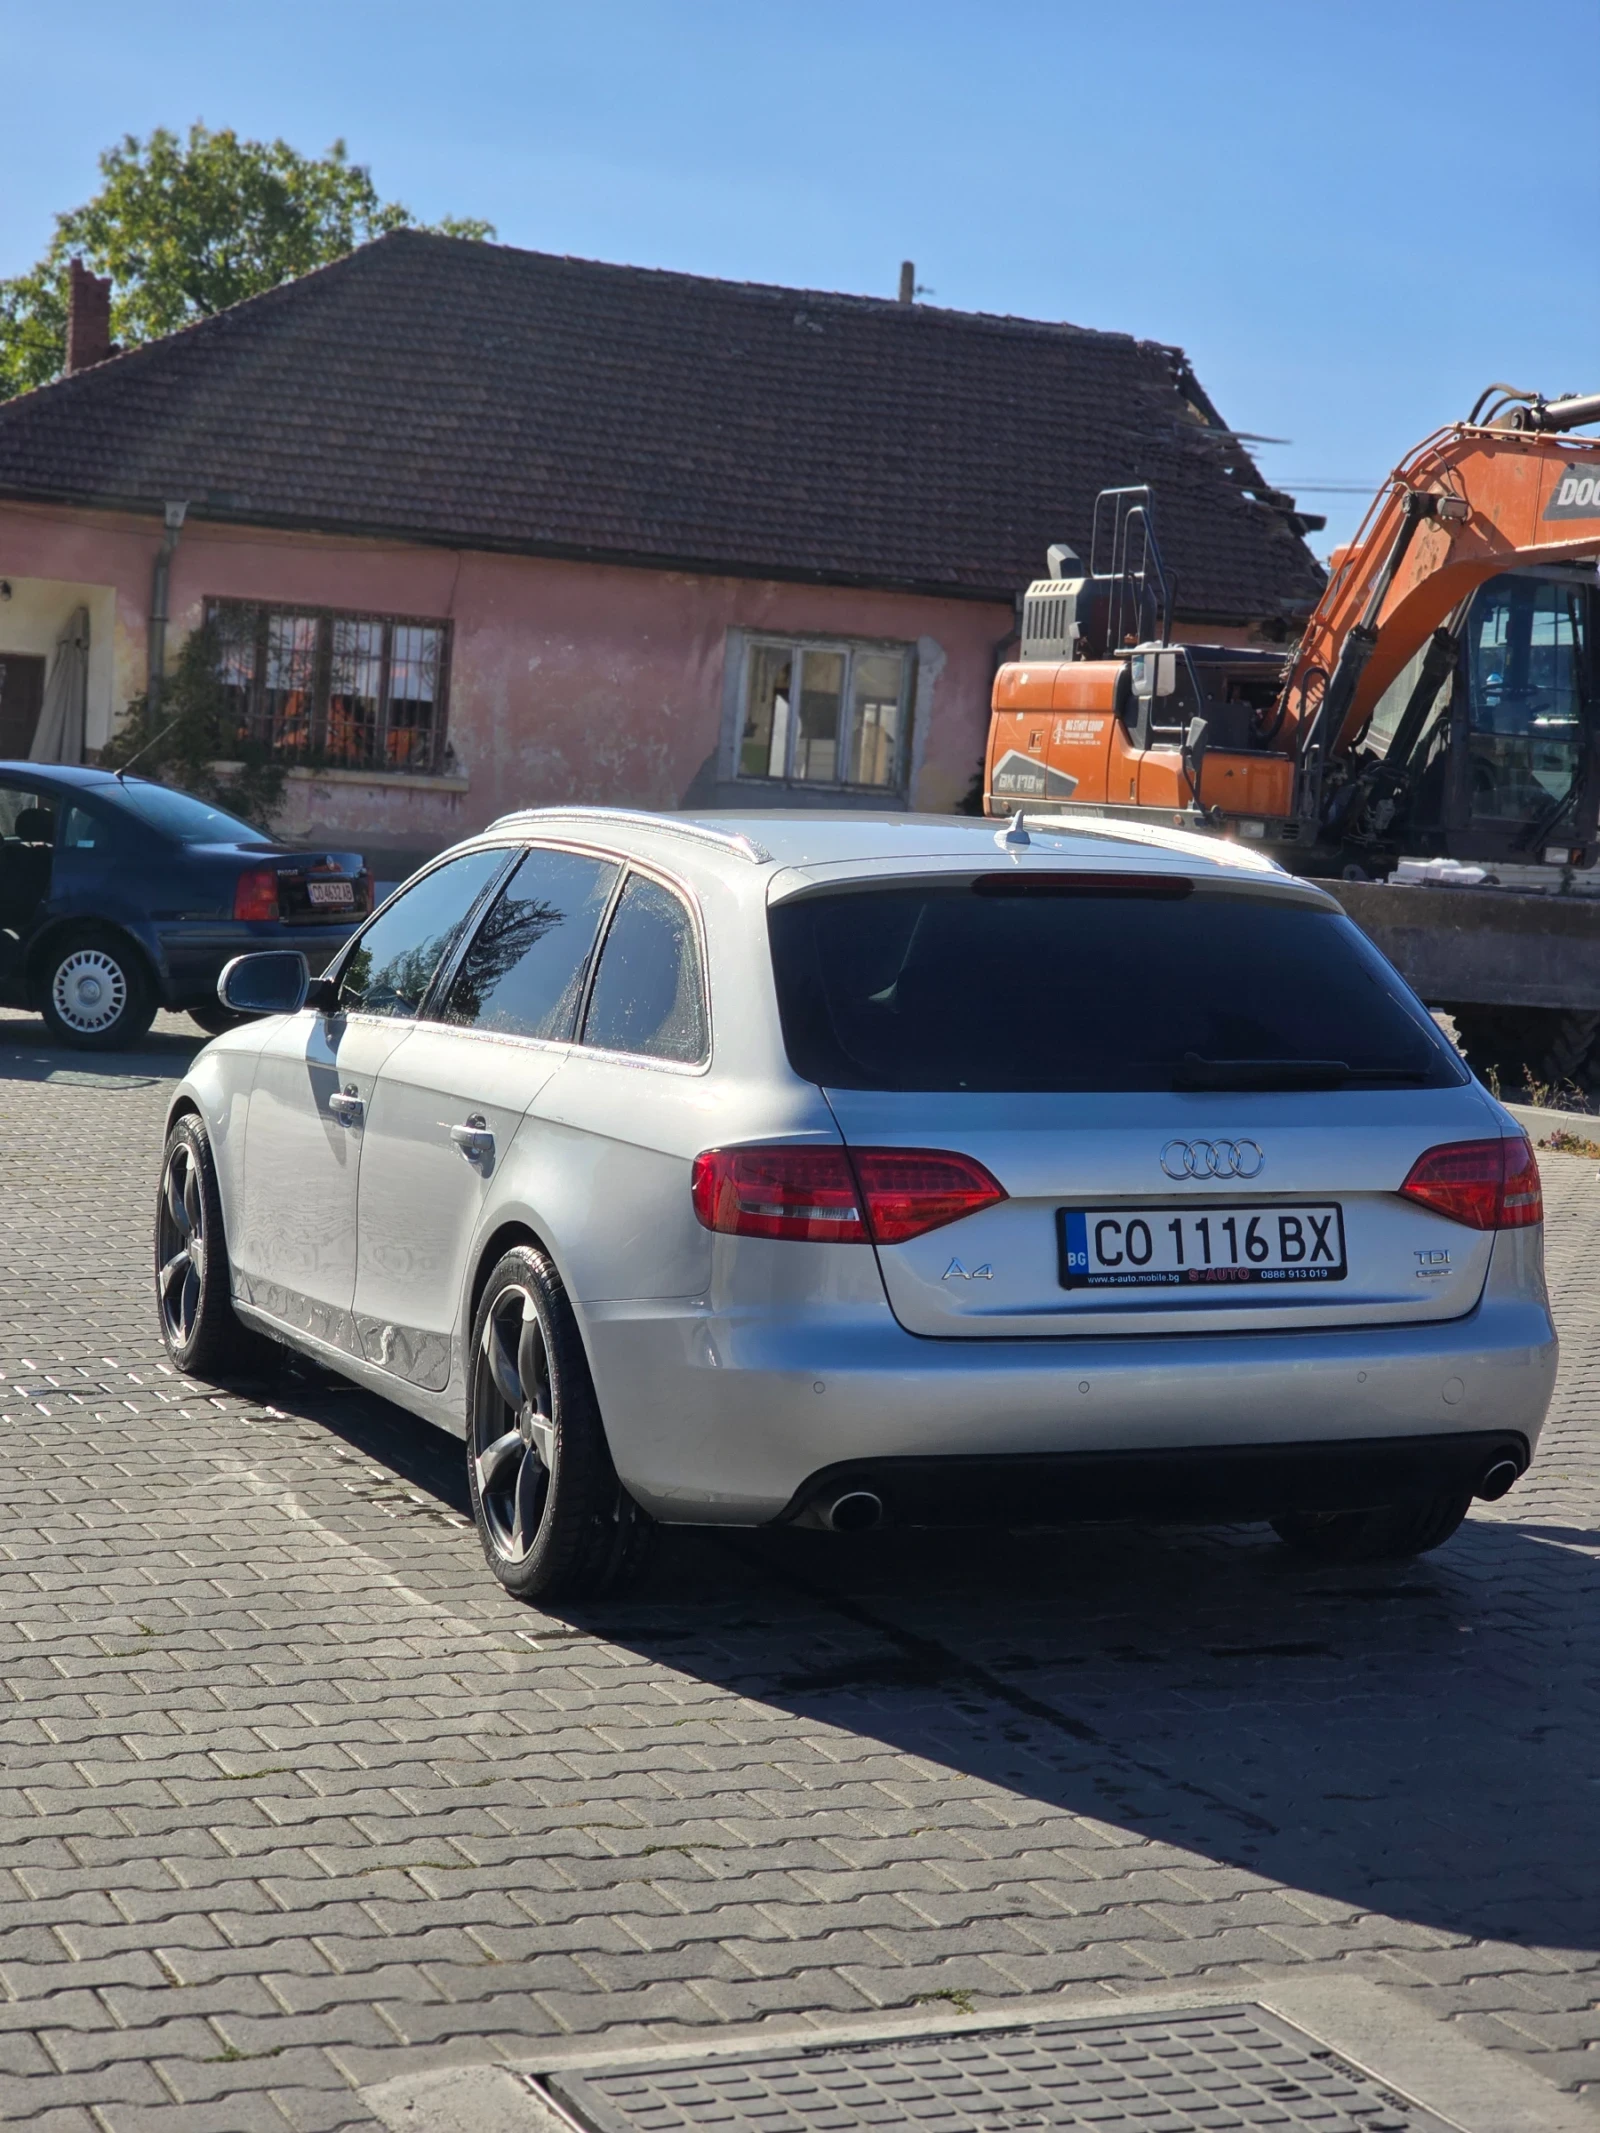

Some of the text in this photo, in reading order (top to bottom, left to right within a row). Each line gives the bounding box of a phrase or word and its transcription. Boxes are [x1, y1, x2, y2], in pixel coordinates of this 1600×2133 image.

[1094, 1214, 1335, 1267] CO 1116 BX
[1067, 1252, 1087, 1267] BG
[1413, 1249, 1450, 1265] TDI
[942, 1257, 994, 1280] A4
[1087, 1268, 1328, 1284] www.s-auto.mobile.bg S-AUTO 0888 913 019
